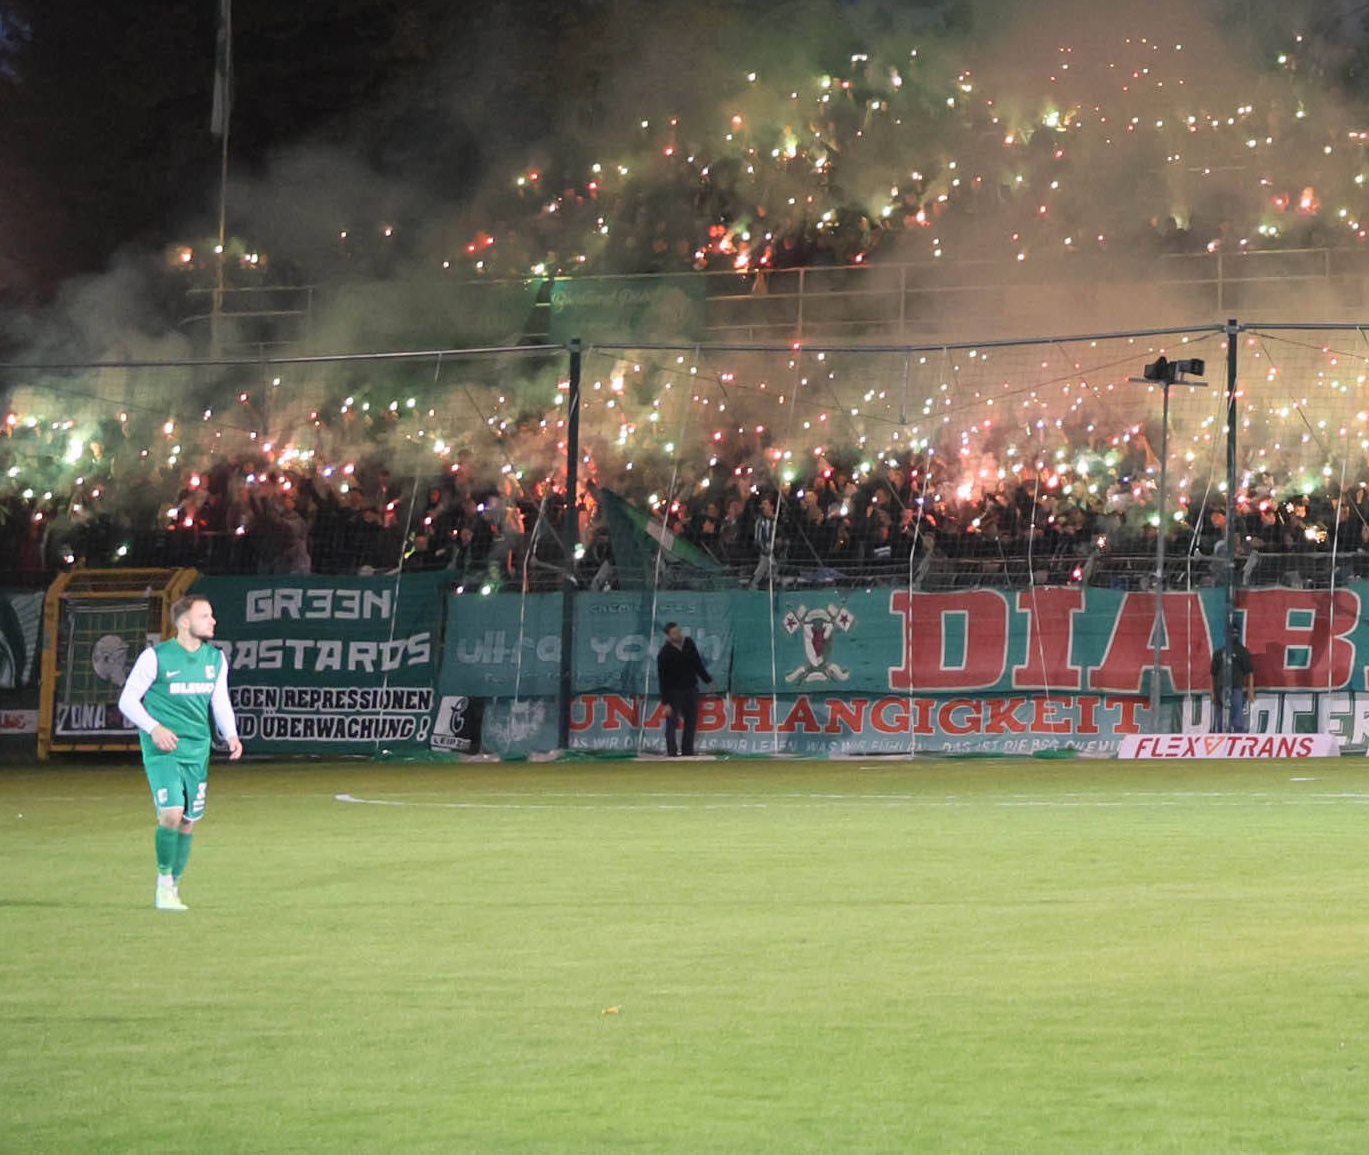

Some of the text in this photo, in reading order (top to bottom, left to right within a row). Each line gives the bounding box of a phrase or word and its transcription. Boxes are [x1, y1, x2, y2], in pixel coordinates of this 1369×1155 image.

[229, 686, 433, 712] EGEN REPRESSIONEN
[220, 713, 256, 739] ND
[1134, 737, 1315, 759] FLEX TRANS
